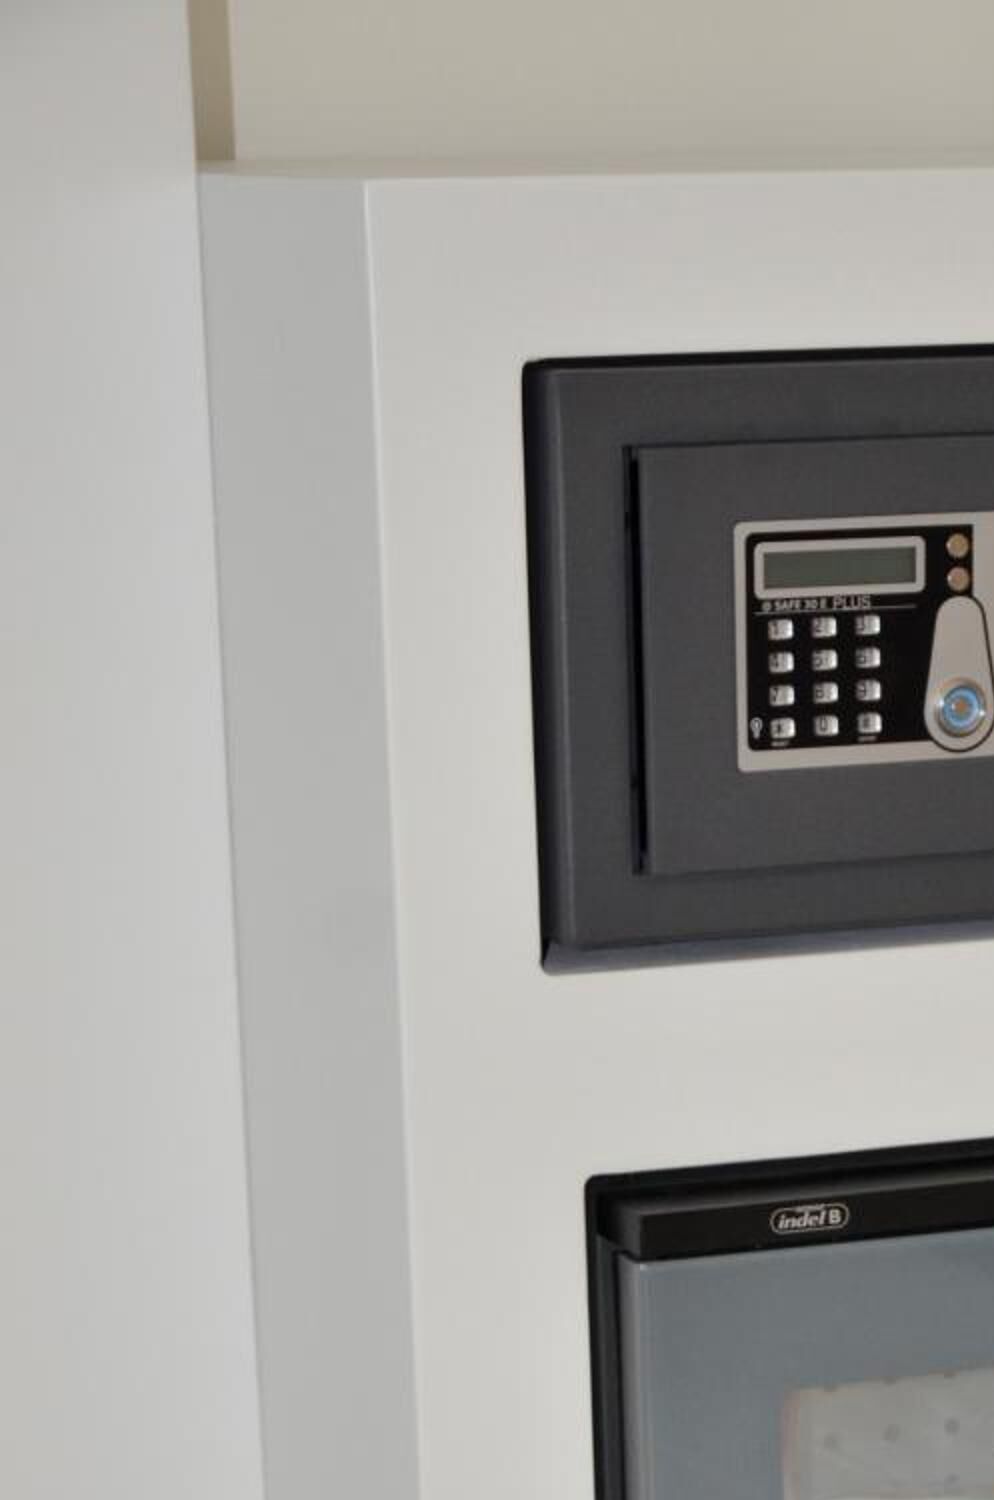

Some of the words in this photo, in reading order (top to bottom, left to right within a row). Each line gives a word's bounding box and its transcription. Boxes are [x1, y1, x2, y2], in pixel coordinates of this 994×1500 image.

[774, 599, 801, 611] SAFE
[832, 594, 871, 610] PLUS
[778, 1209, 826, 1229] indel
[829, 1209, 842, 1225] B
